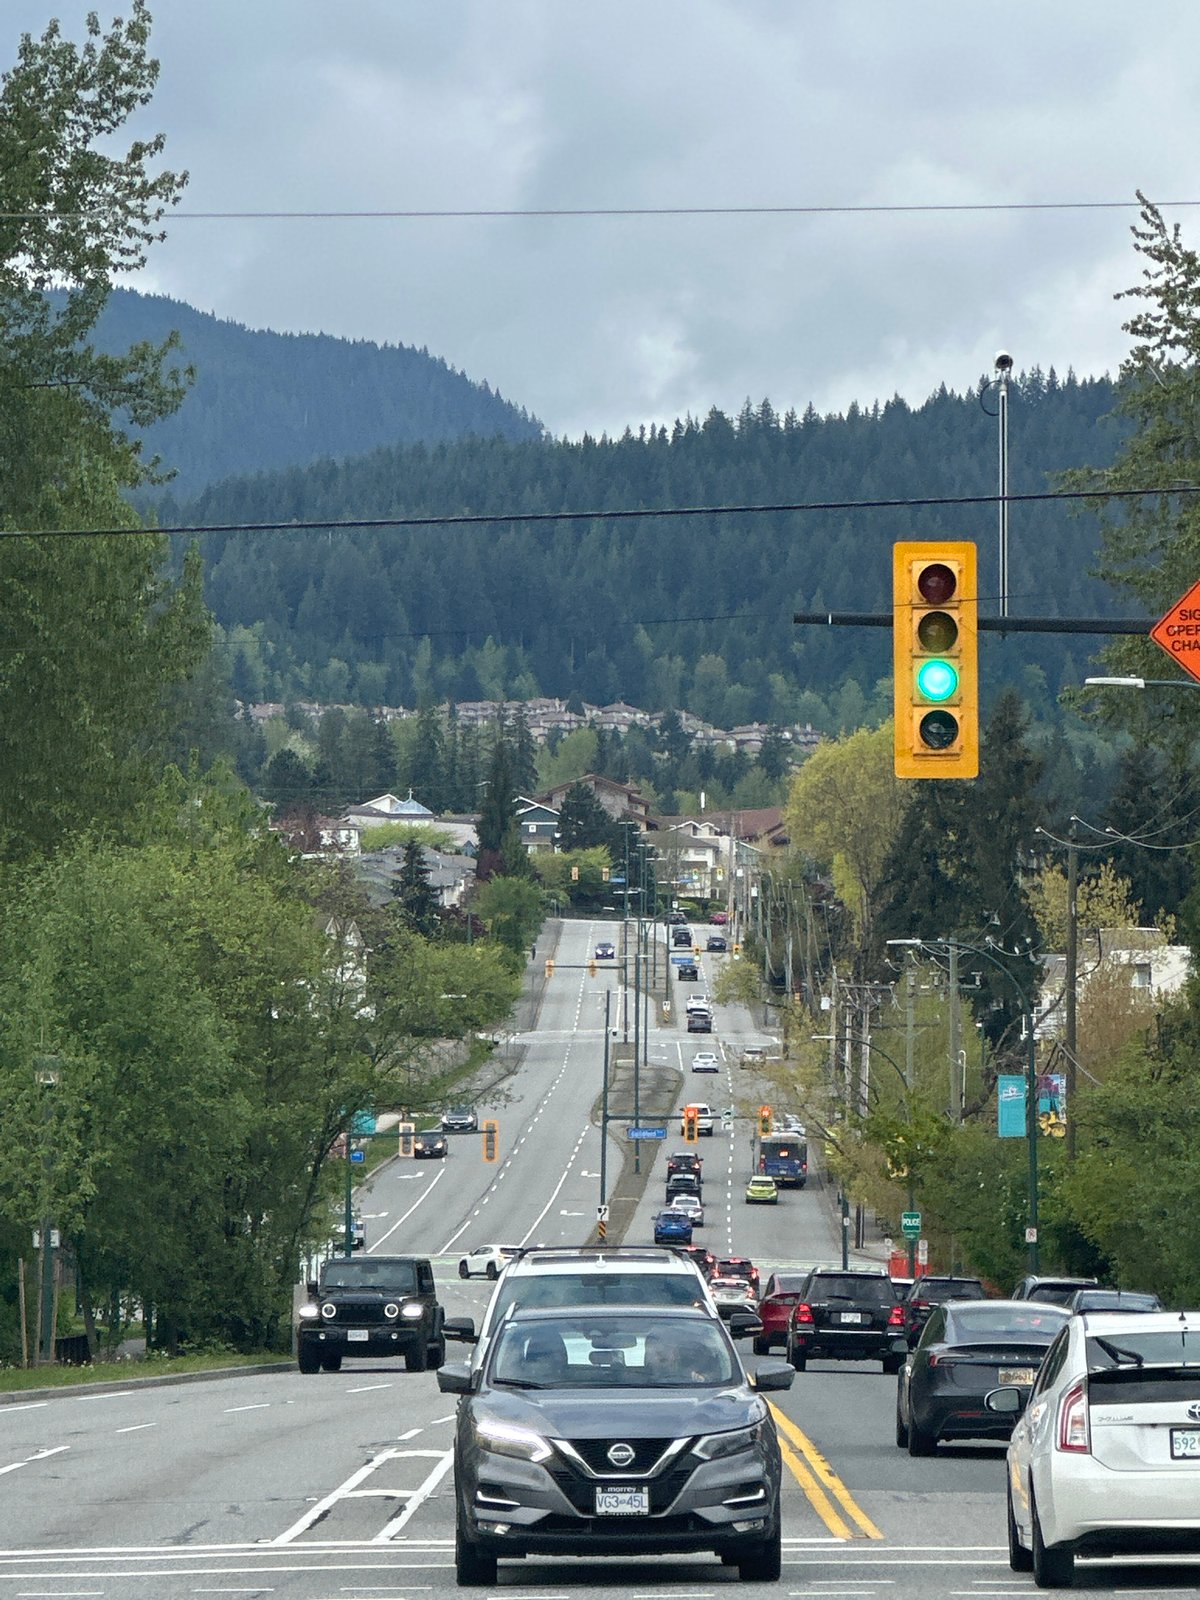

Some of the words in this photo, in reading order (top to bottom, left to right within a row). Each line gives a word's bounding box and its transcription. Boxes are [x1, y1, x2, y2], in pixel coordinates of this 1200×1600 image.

[1179, 609, 1200, 621] SIG
[903, 1218, 920, 1226] POLICE
[1174, 1437, 1196, 1450] 592
[597, 1495, 619, 1509] VG3
[626, 1495, 648, 1509] 45L
